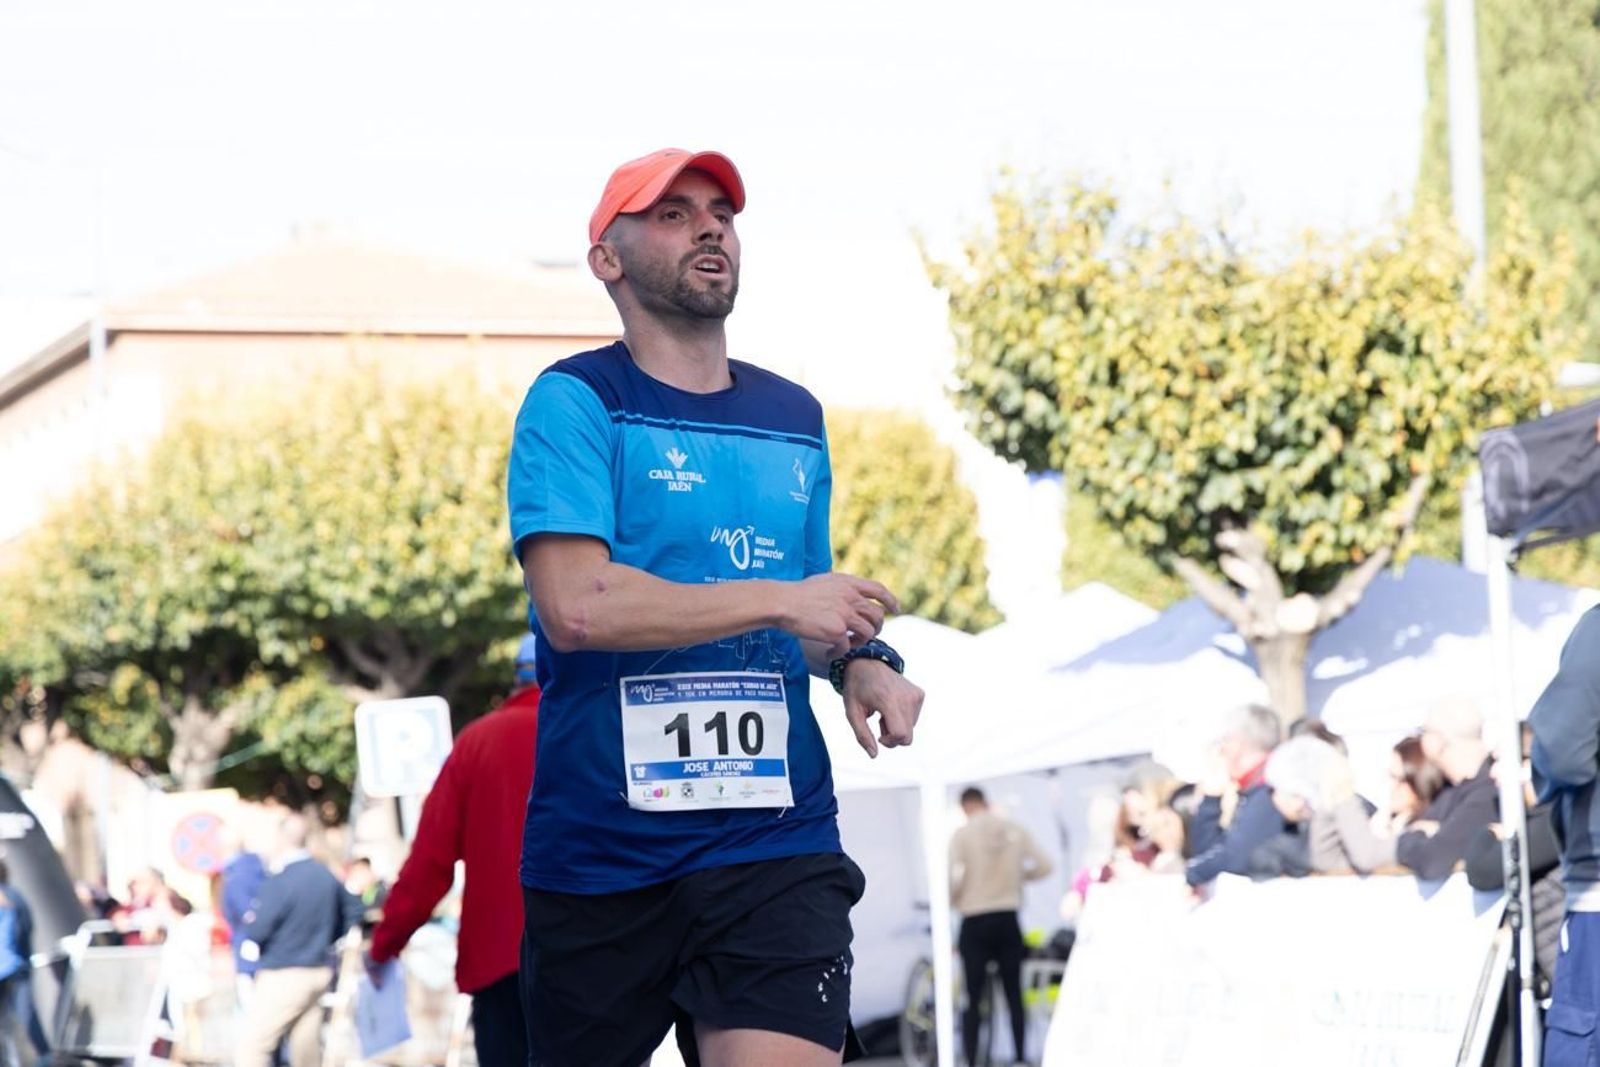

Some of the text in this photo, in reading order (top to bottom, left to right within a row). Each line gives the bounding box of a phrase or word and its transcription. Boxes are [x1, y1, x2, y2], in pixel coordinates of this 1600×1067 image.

[649, 469, 674, 480] CAJA
[664, 711, 764, 758] 110
[683, 761, 710, 774] JOSE
[713, 760, 754, 772] ANTONIO
